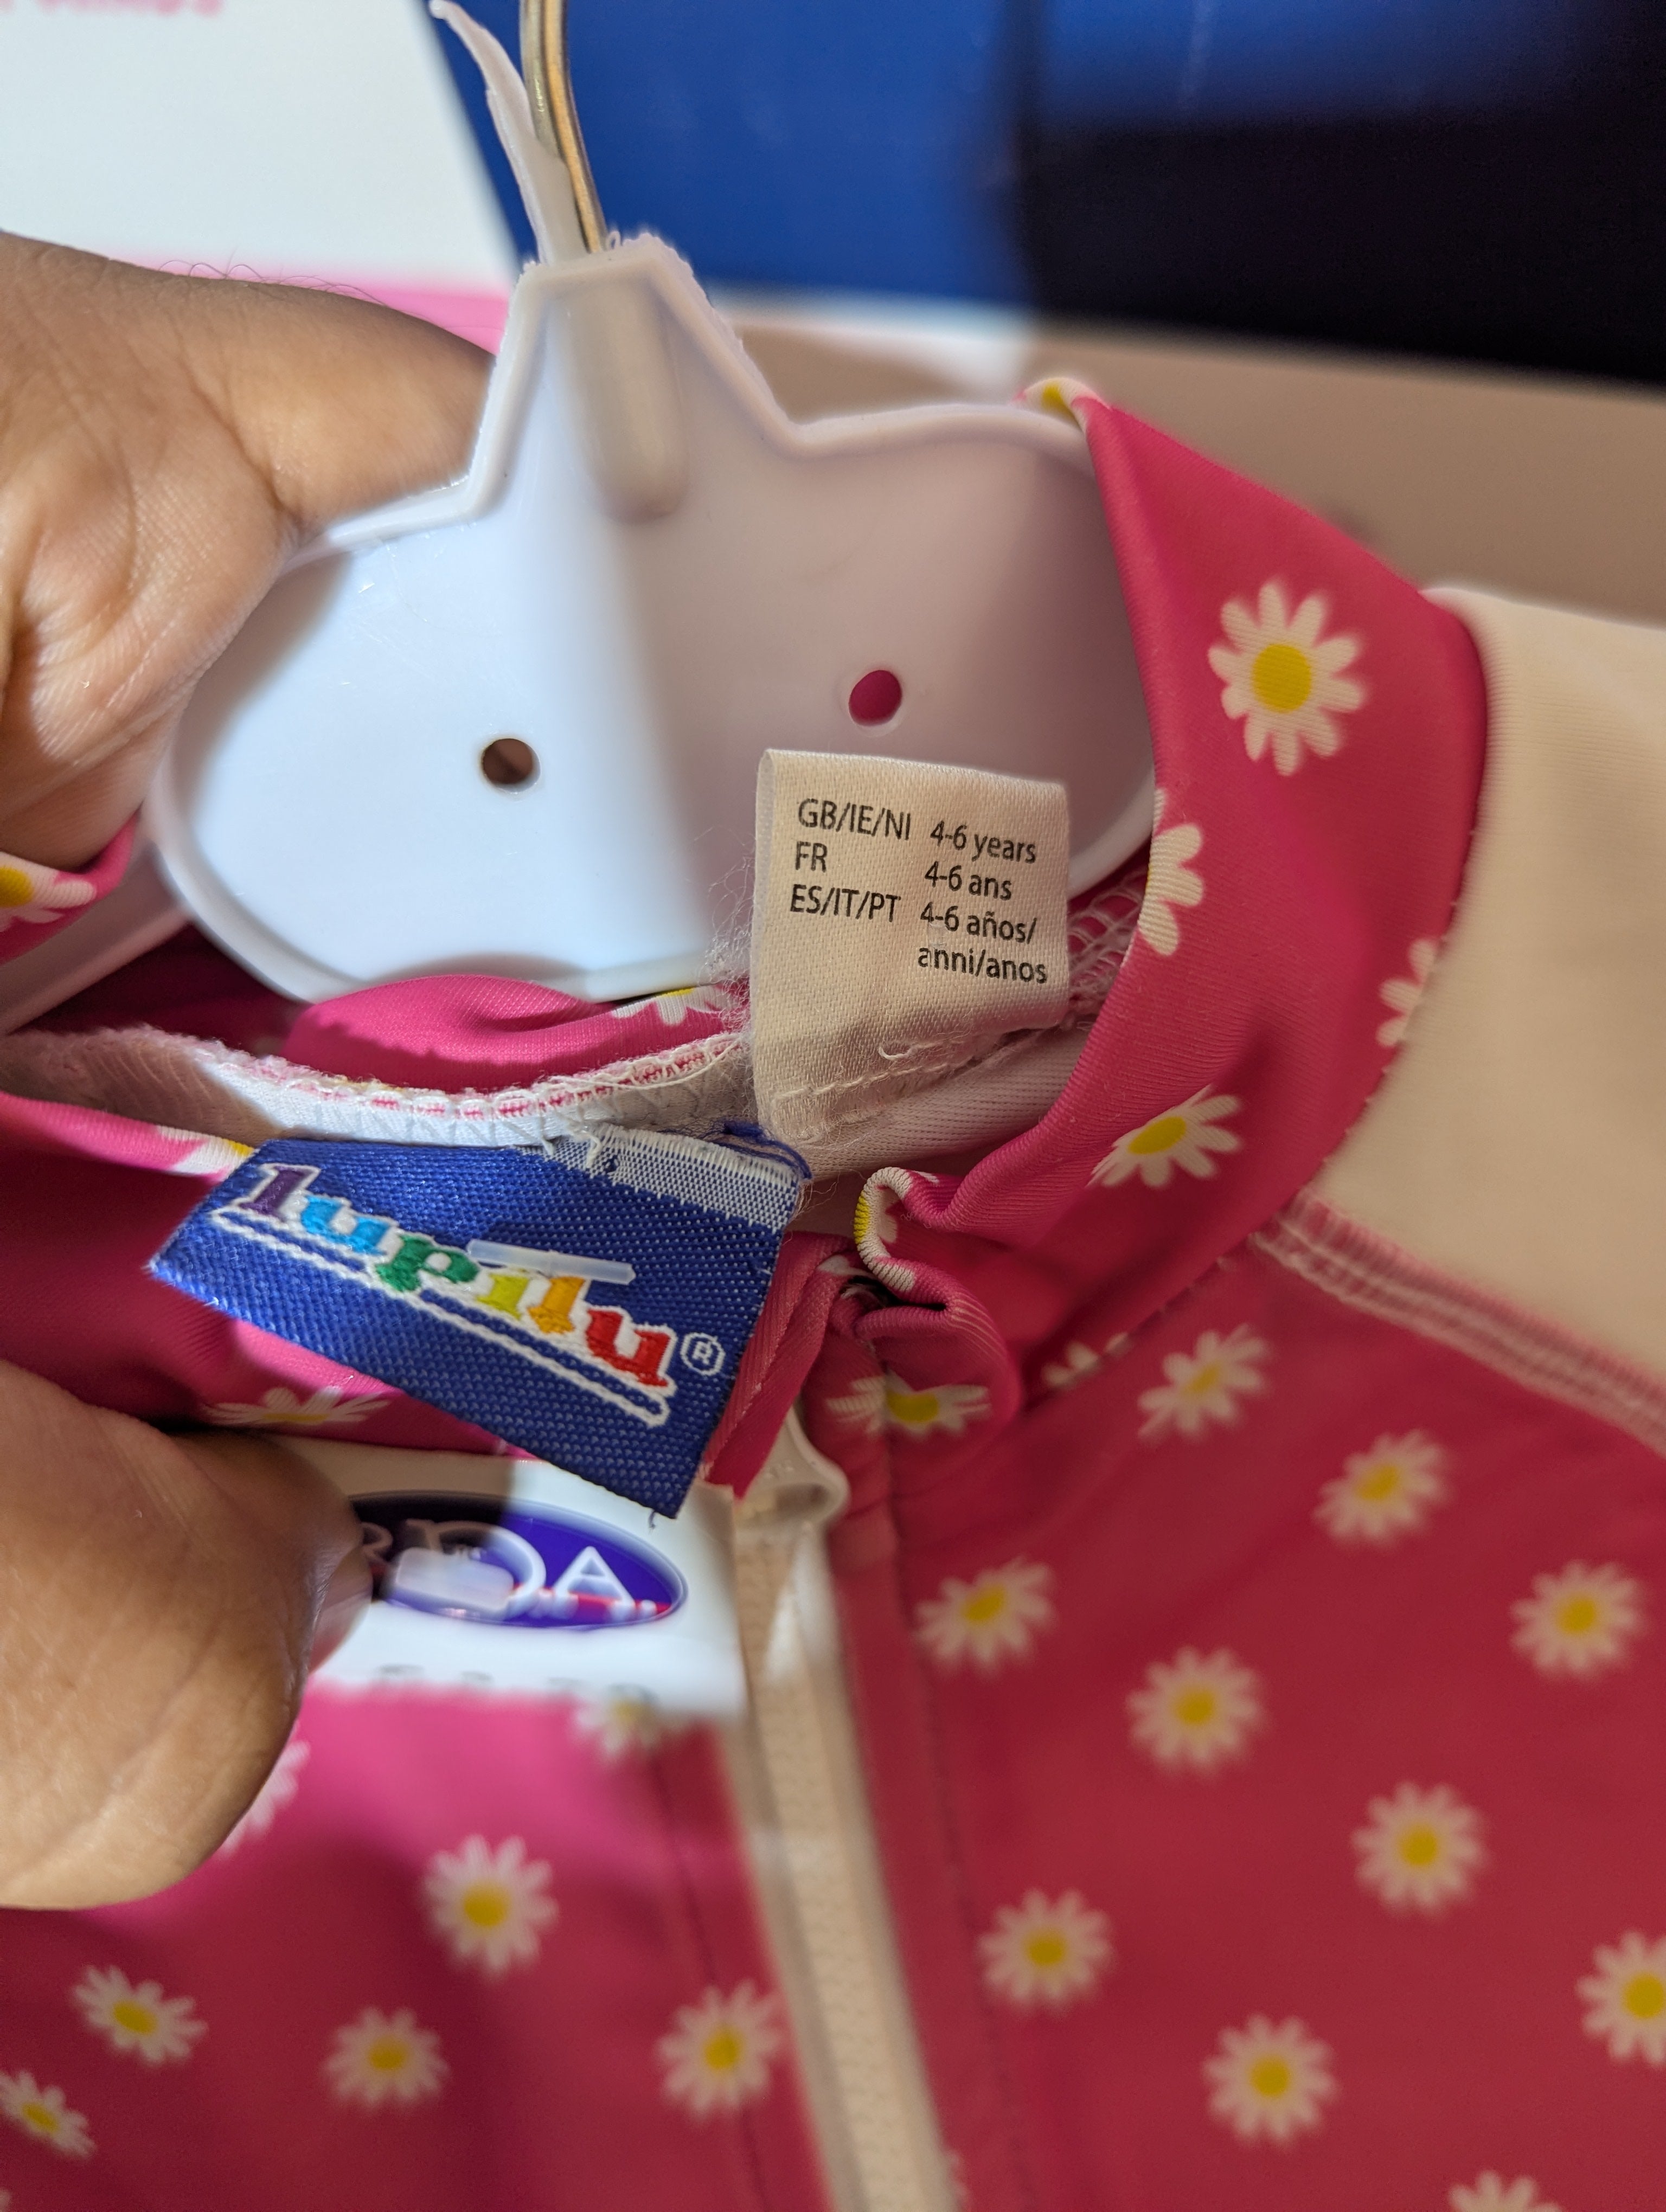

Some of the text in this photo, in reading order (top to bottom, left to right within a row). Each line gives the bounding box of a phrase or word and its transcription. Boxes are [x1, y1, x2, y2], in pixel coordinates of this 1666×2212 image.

[798, 798, 1036, 864] GB/IE/NI 4-6 years
[795, 841, 1012, 901] FR 4-6 ans
[790, 884, 1037, 944] ES/IT/PT 4-6 años/
[918, 947, 1047, 984] anni/anos
